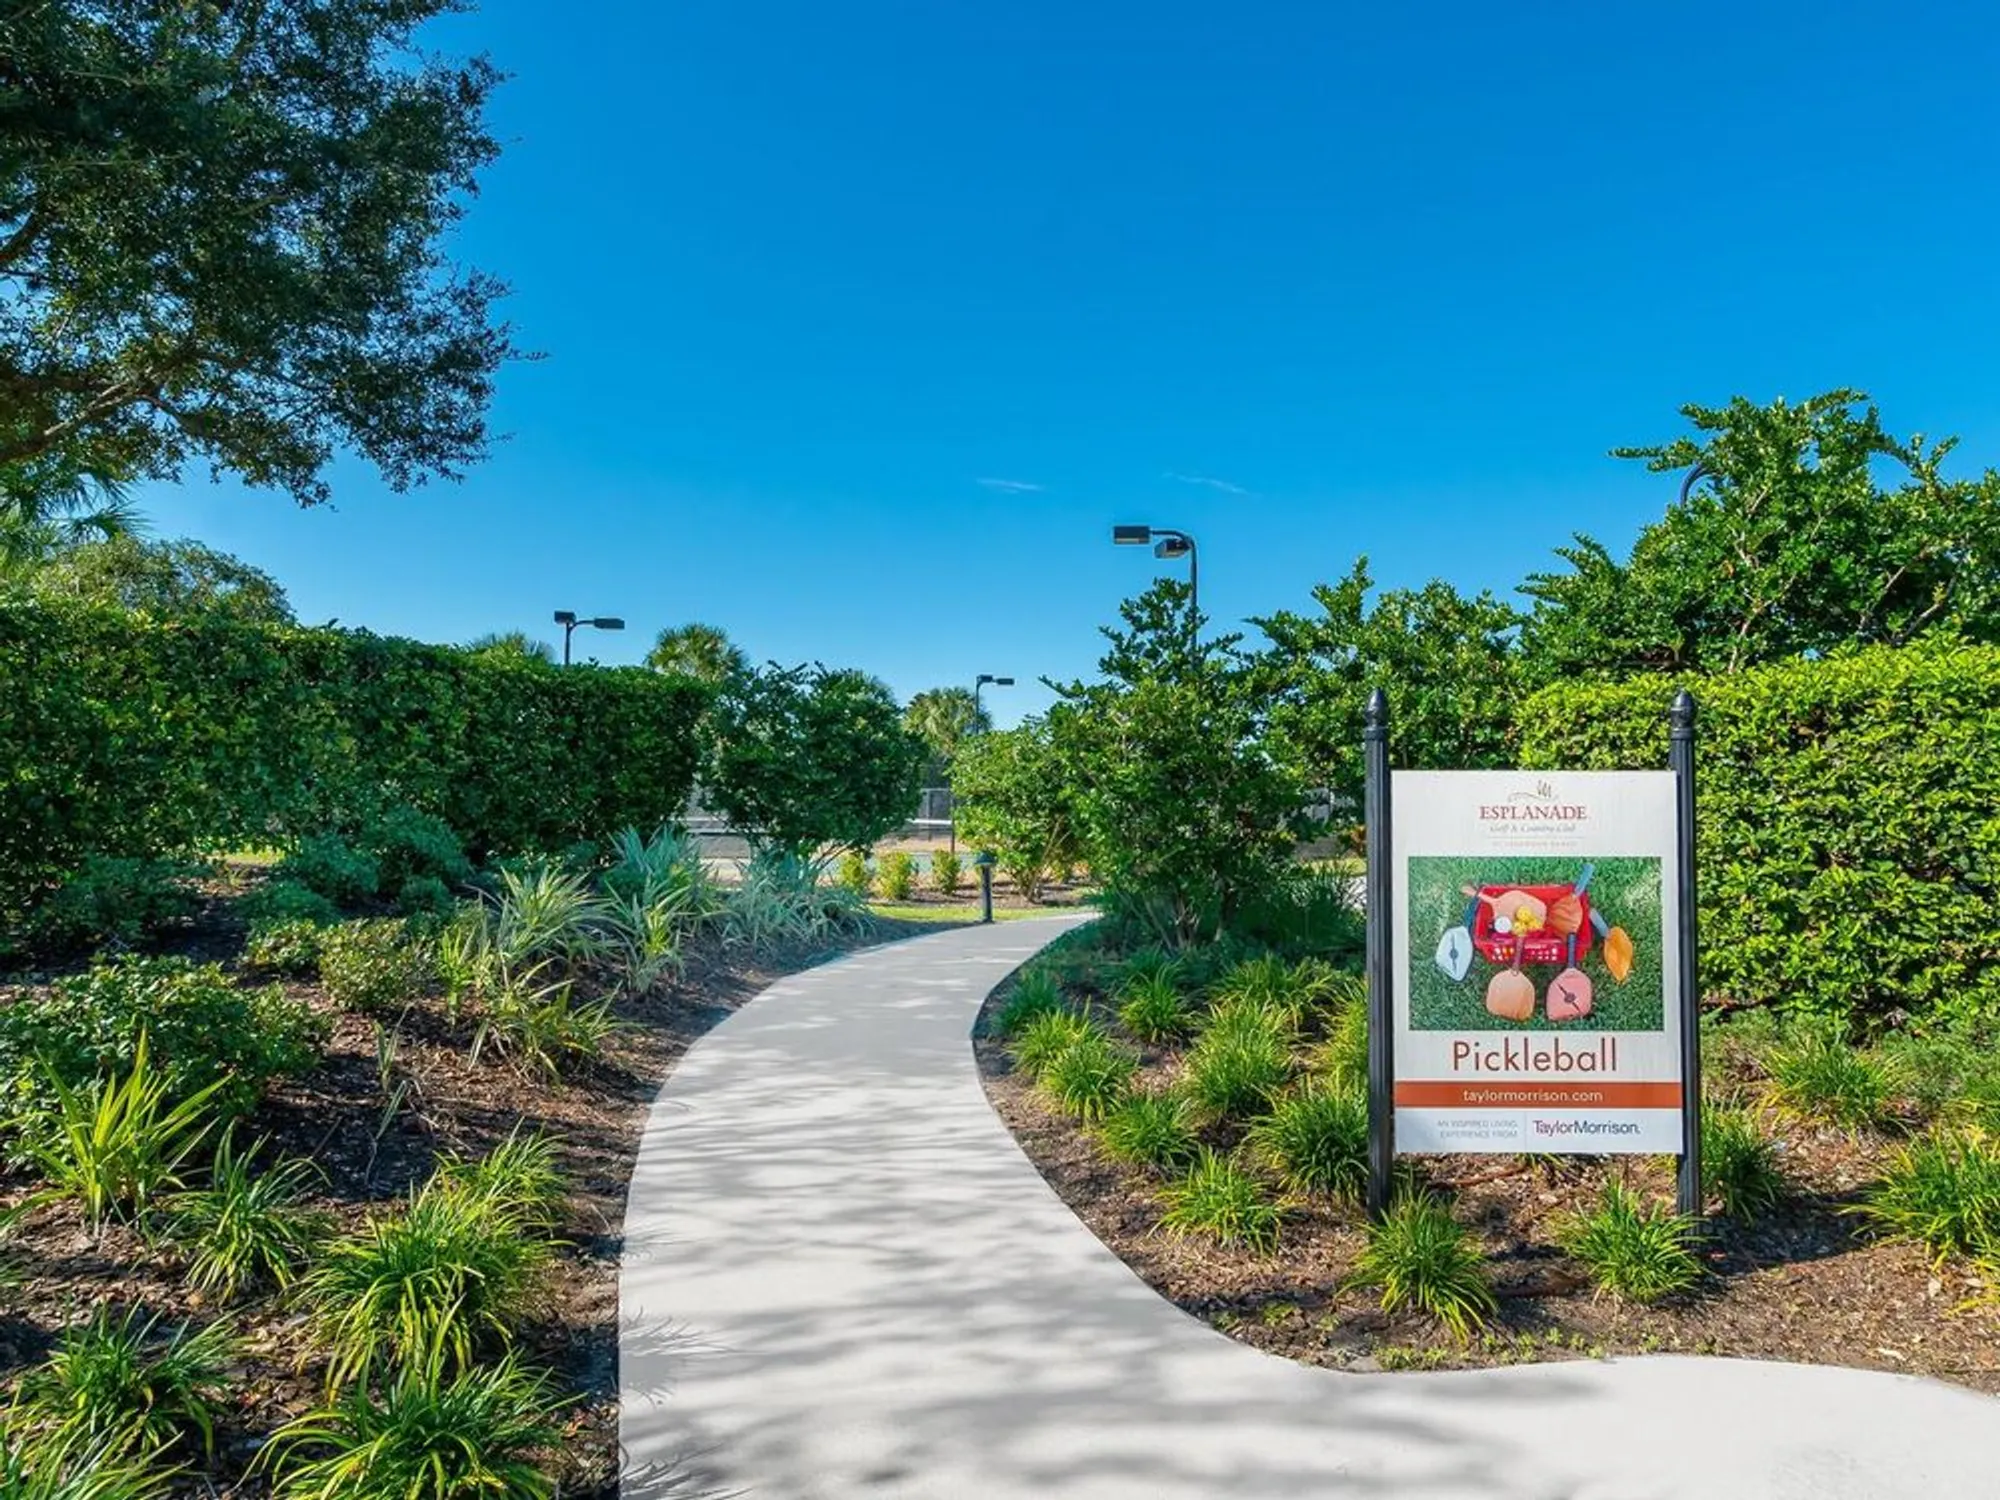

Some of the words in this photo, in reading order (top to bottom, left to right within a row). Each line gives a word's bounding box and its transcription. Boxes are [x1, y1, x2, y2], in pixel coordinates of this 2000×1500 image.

[1479, 805, 1588, 820] ESPLANADE
[1453, 1037, 1617, 1072] Pickleball
[1463, 1088, 1603, 1103] taylormorrison.com
